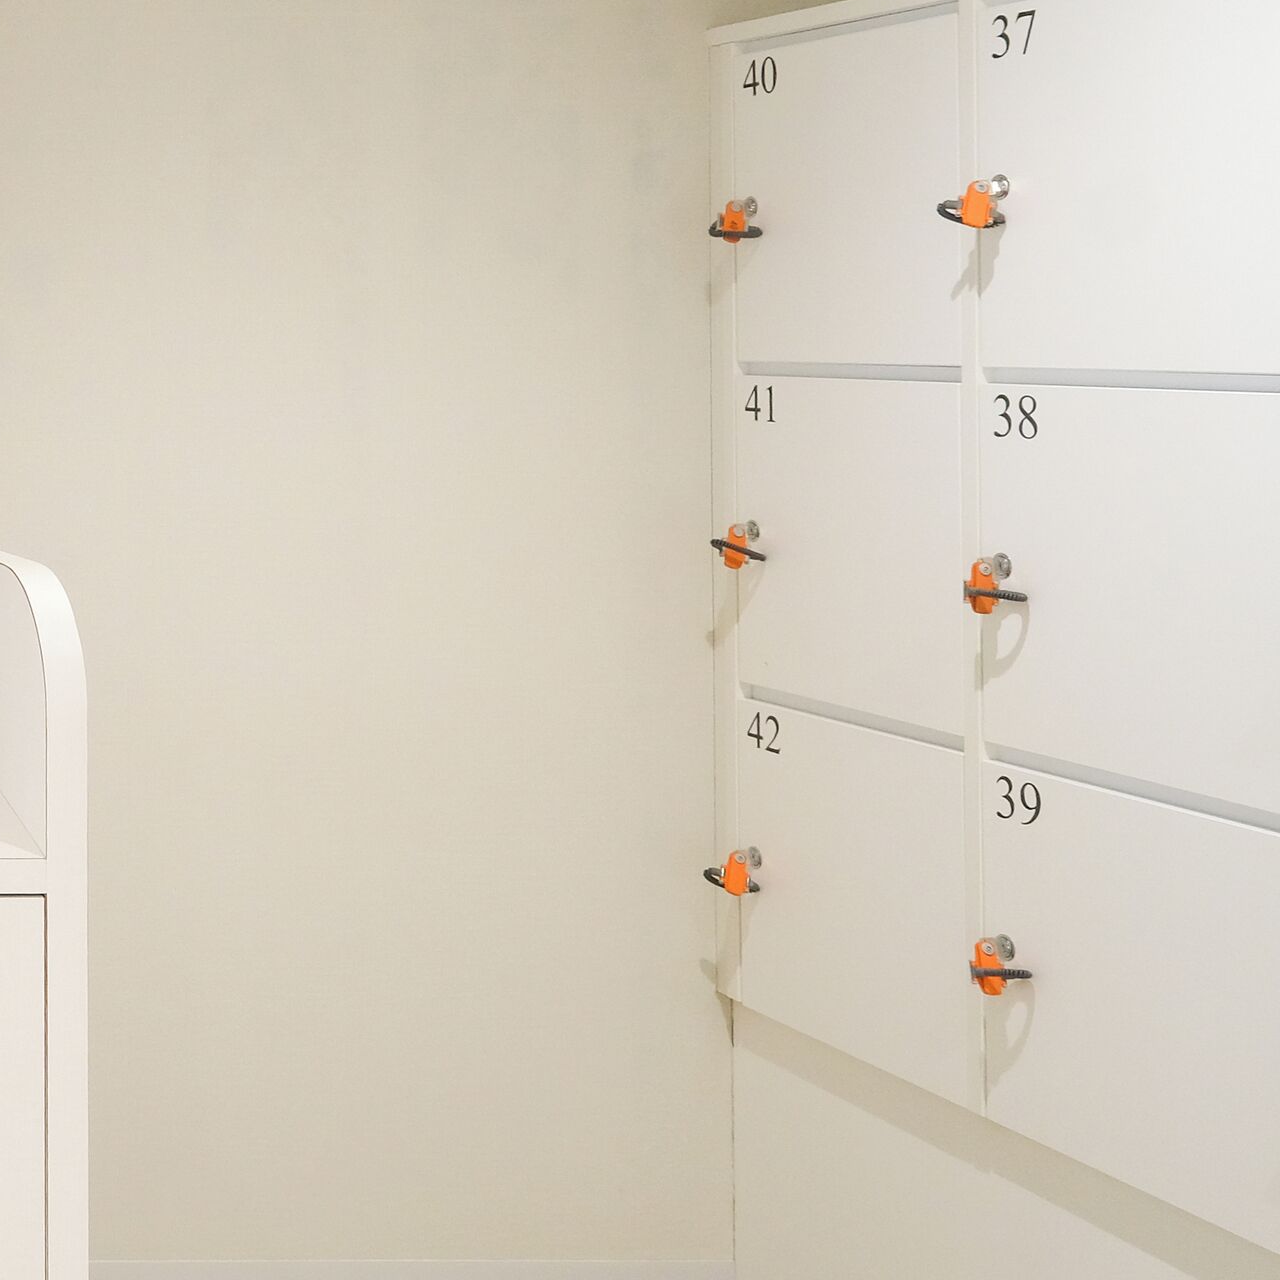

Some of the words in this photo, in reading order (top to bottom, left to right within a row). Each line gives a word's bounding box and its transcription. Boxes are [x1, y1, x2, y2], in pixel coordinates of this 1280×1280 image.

[991, 9, 1037, 59] 37
[742, 56, 778, 96] 40
[744, 384, 777, 424] 41
[993, 394, 1039, 441] 38
[746, 711, 782, 756] 42
[996, 775, 1043, 827] 39
